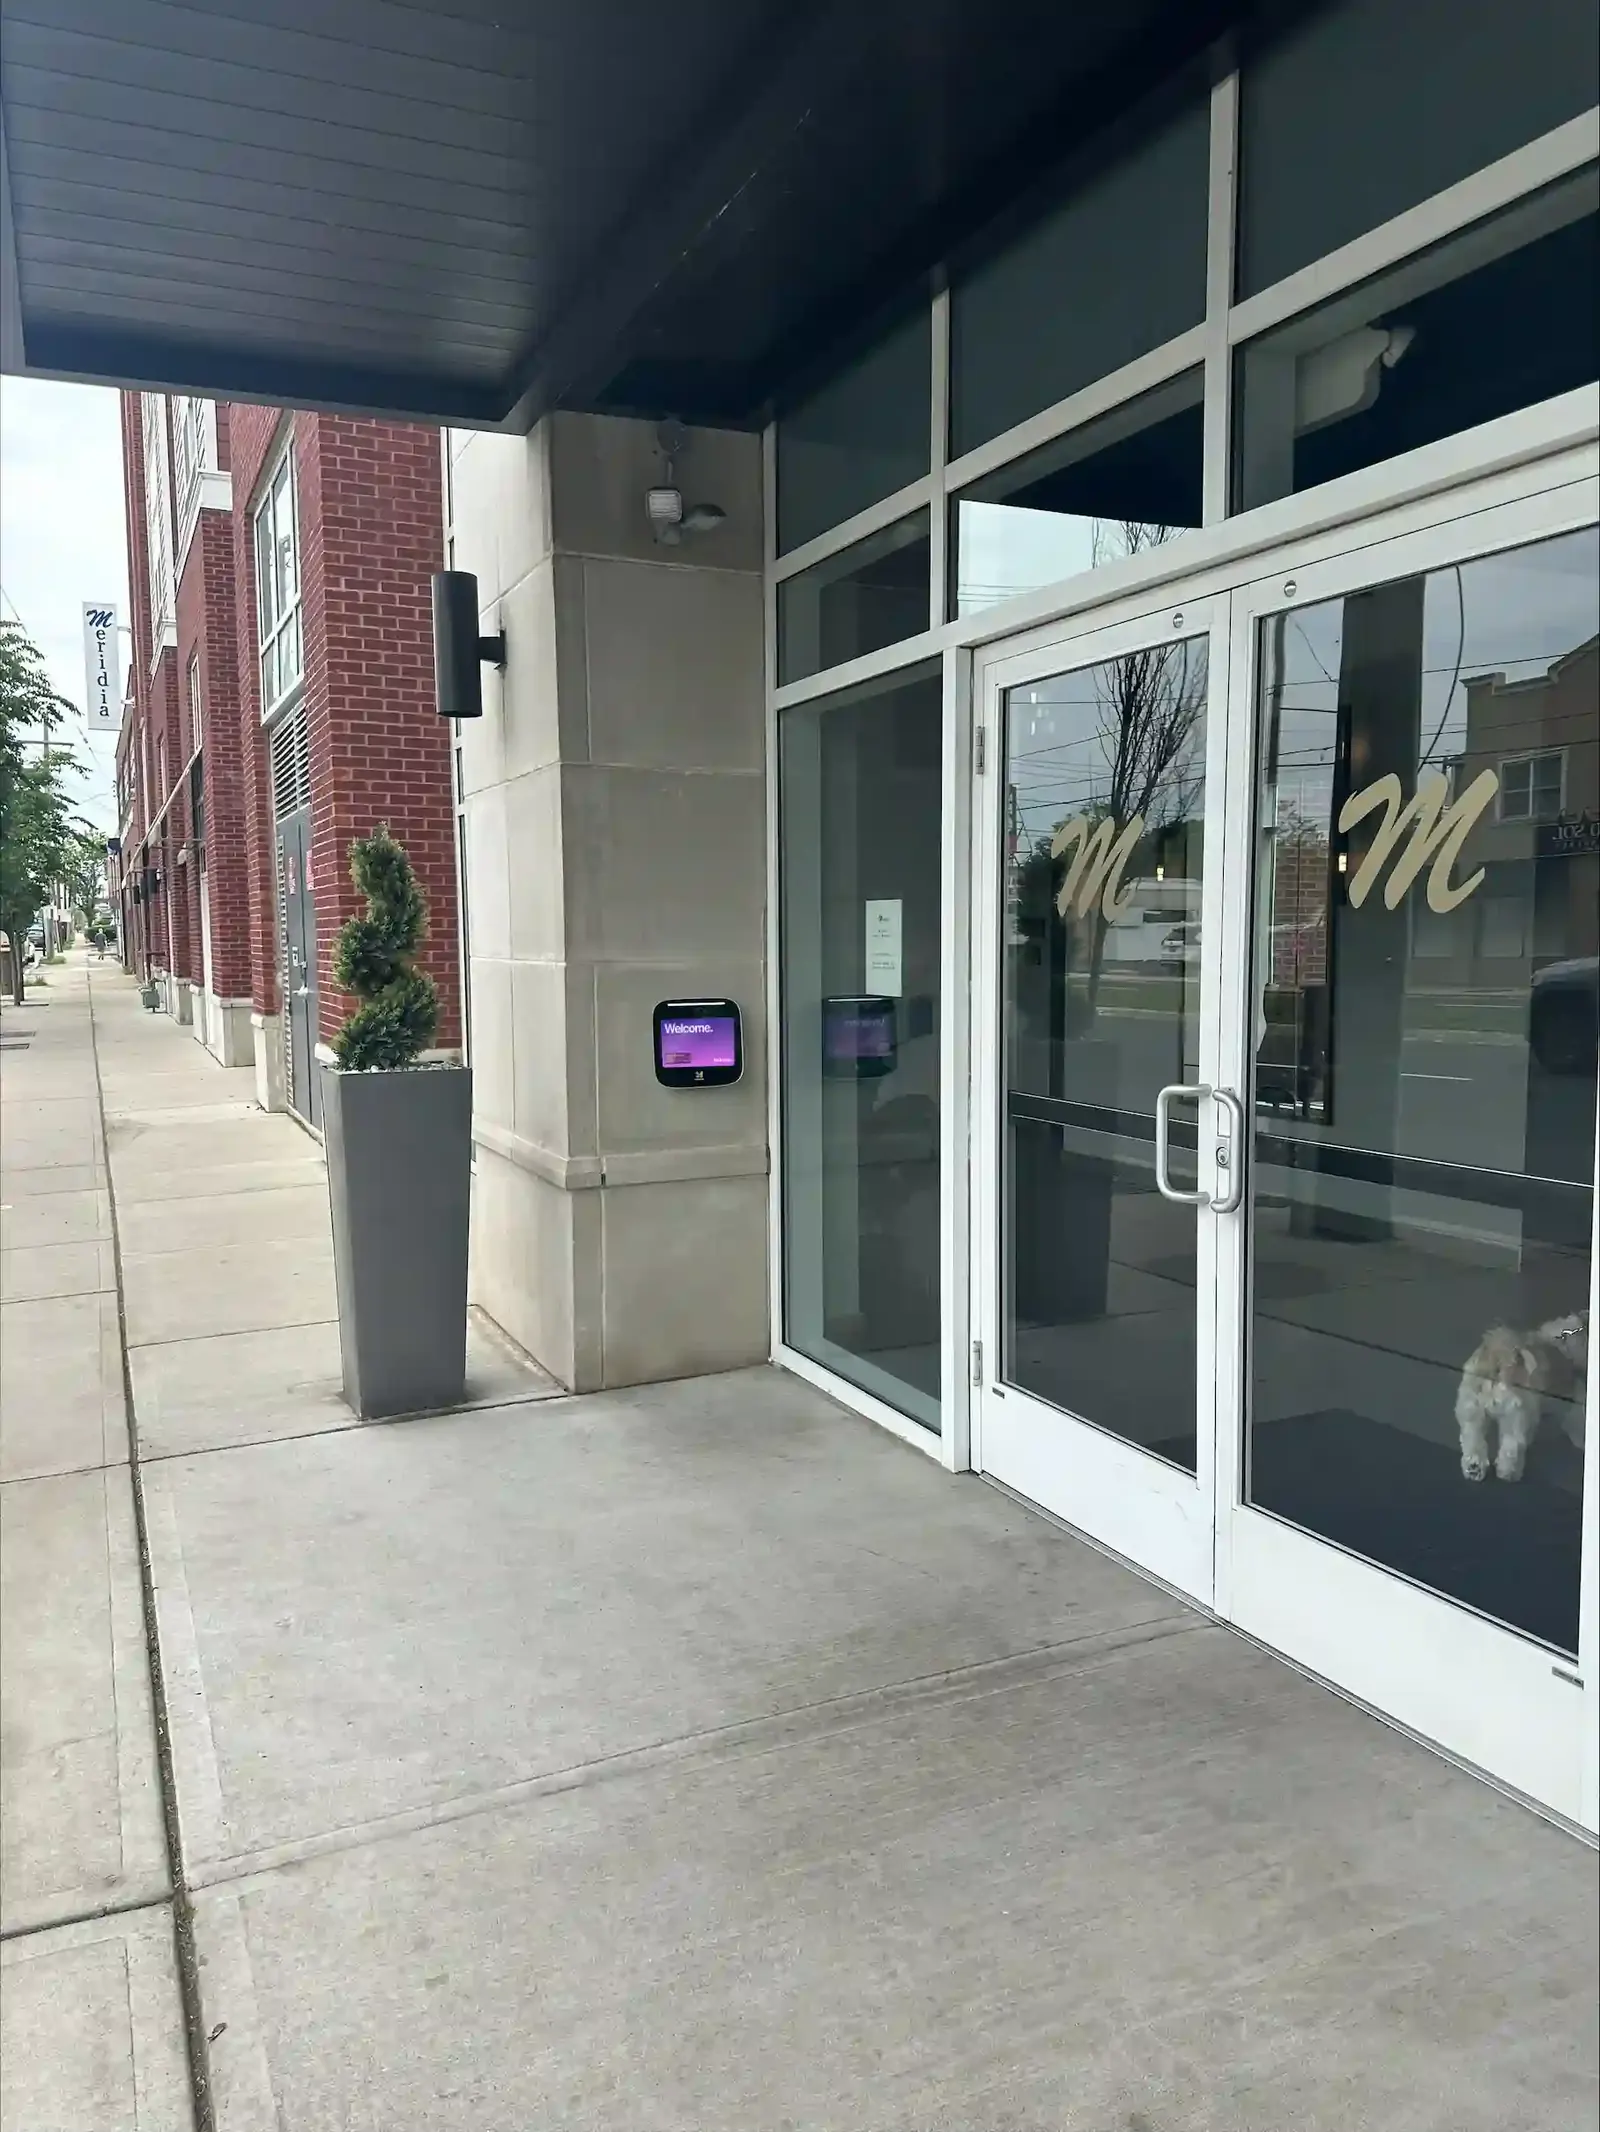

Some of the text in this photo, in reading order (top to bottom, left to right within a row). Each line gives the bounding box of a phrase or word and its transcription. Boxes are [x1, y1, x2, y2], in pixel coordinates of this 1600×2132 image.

[86, 608, 114, 717] Meridia
[1051, 811, 1145, 923] M
[1338, 768, 1499, 914] M
